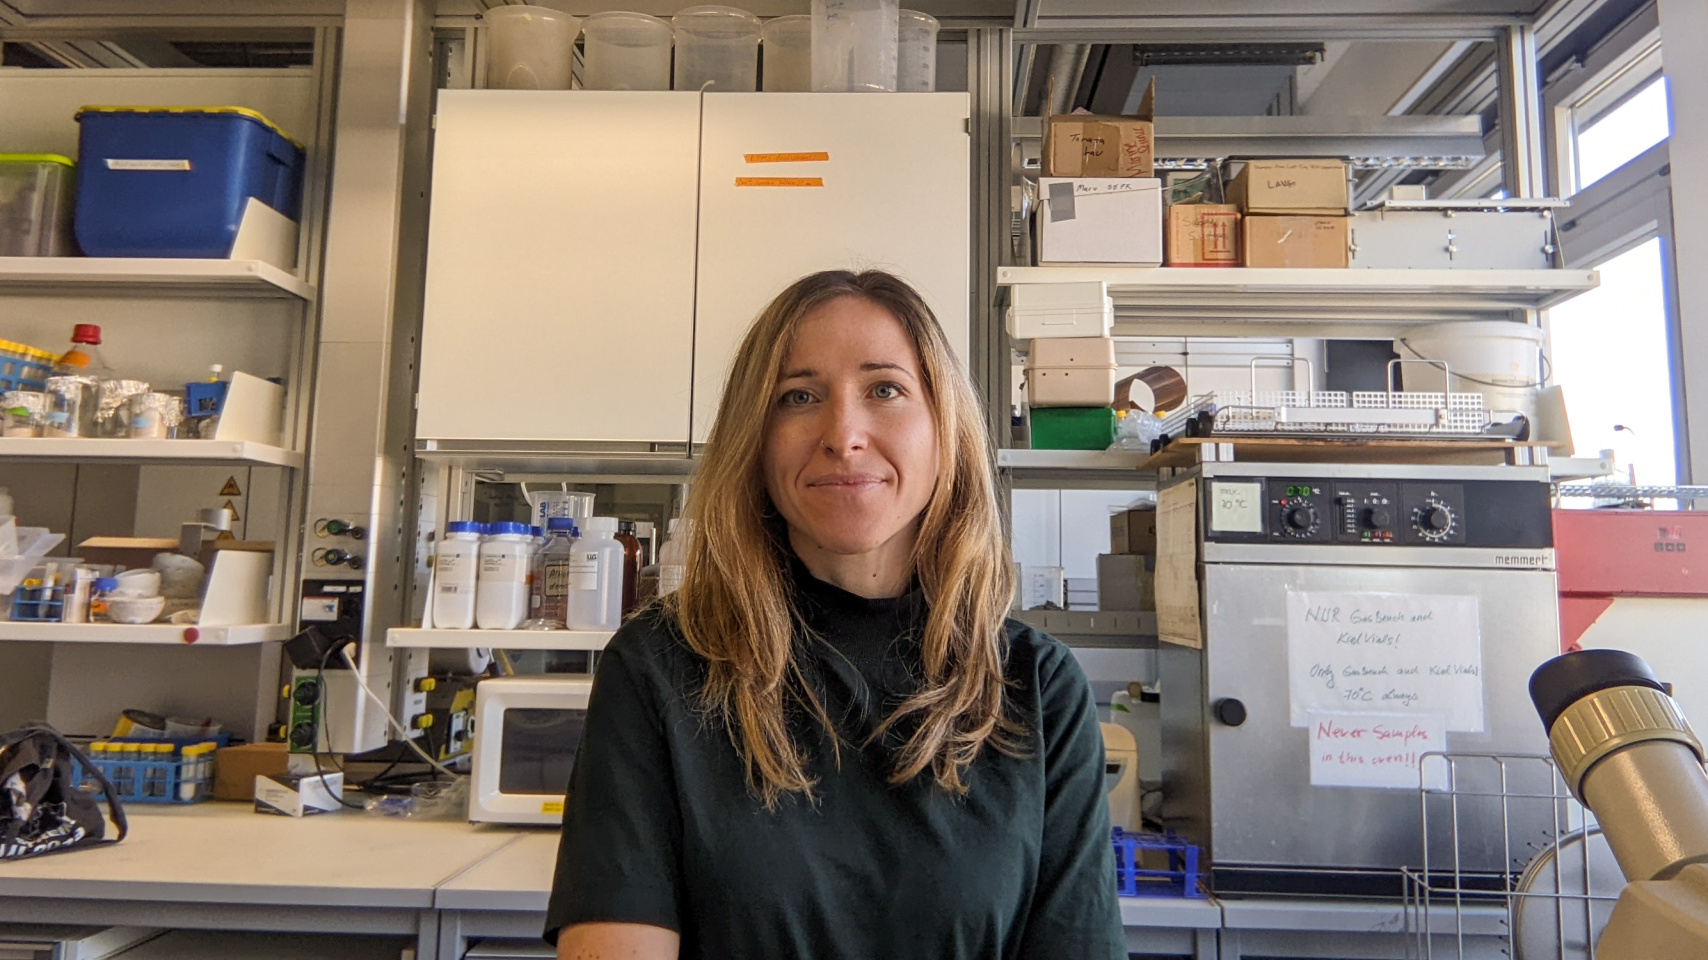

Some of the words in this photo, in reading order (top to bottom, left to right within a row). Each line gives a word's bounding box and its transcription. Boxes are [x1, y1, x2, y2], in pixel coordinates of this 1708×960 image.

[1495, 554, 1548, 565] memmert
[1305, 606, 1340, 622] NUR
[1410, 611, 1433, 622] and
[1310, 664, 1334, 689] Only
[1397, 666, 1419, 675] and
[1381, 689, 1418, 705] always
[1317, 719, 1368, 740] Never
[1372, 724, 1428, 746] Samples
[1322, 754, 1332, 762] in
[1338, 751, 1364, 765] this
